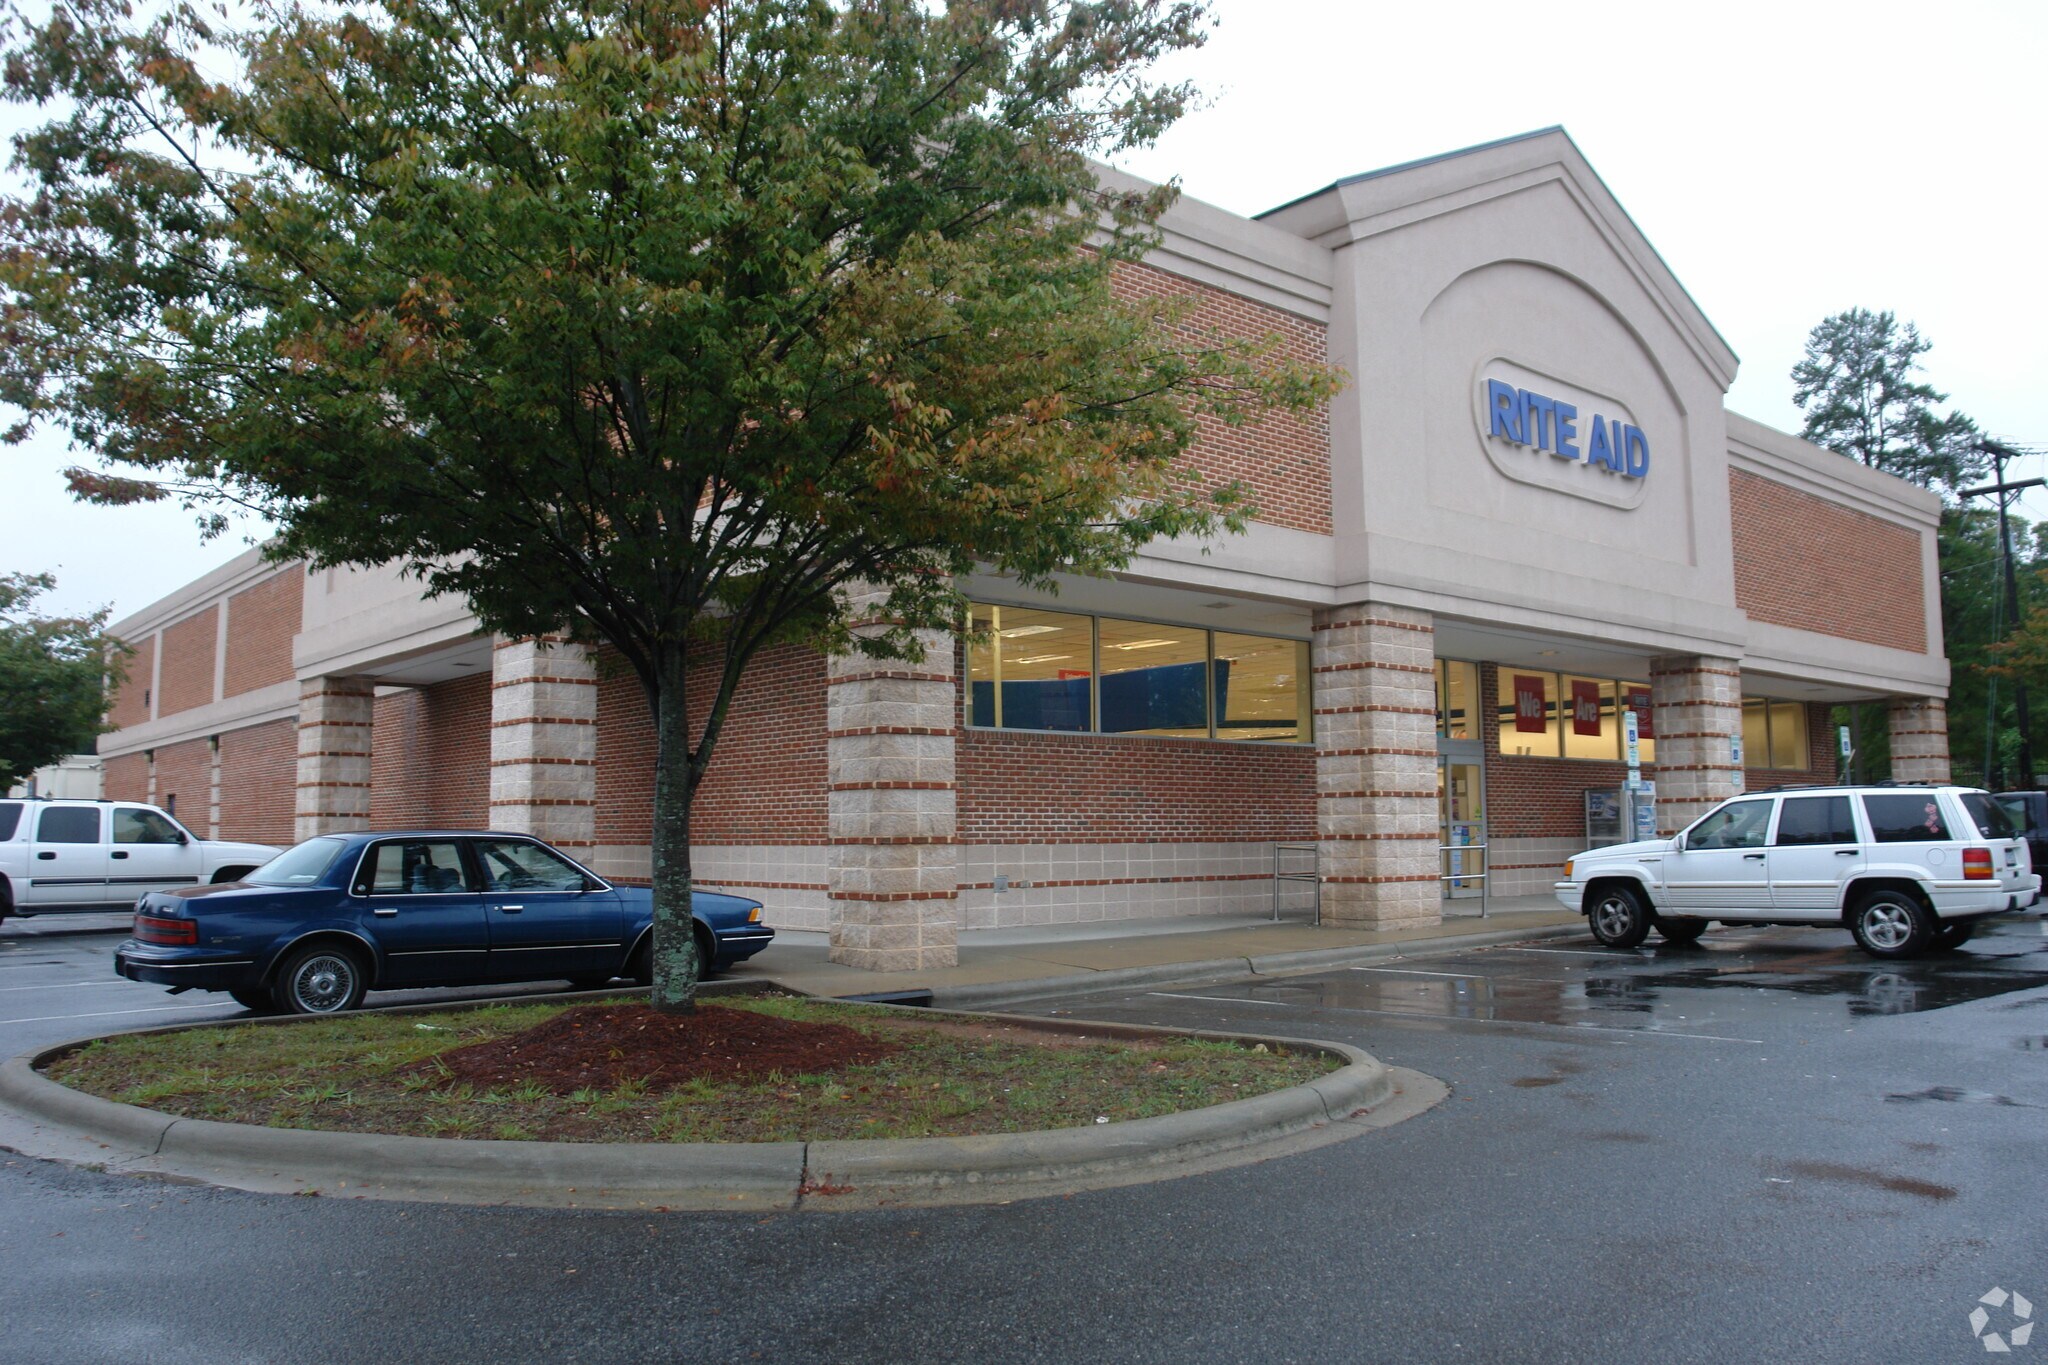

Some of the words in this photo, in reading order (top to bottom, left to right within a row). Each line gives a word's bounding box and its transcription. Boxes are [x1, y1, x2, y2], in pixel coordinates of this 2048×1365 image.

[1487, 378, 1580, 460] RITE
[1587, 413, 1650, 478] AID
[1519, 691, 1541, 718] We
[1576, 695, 1597, 722] Are
